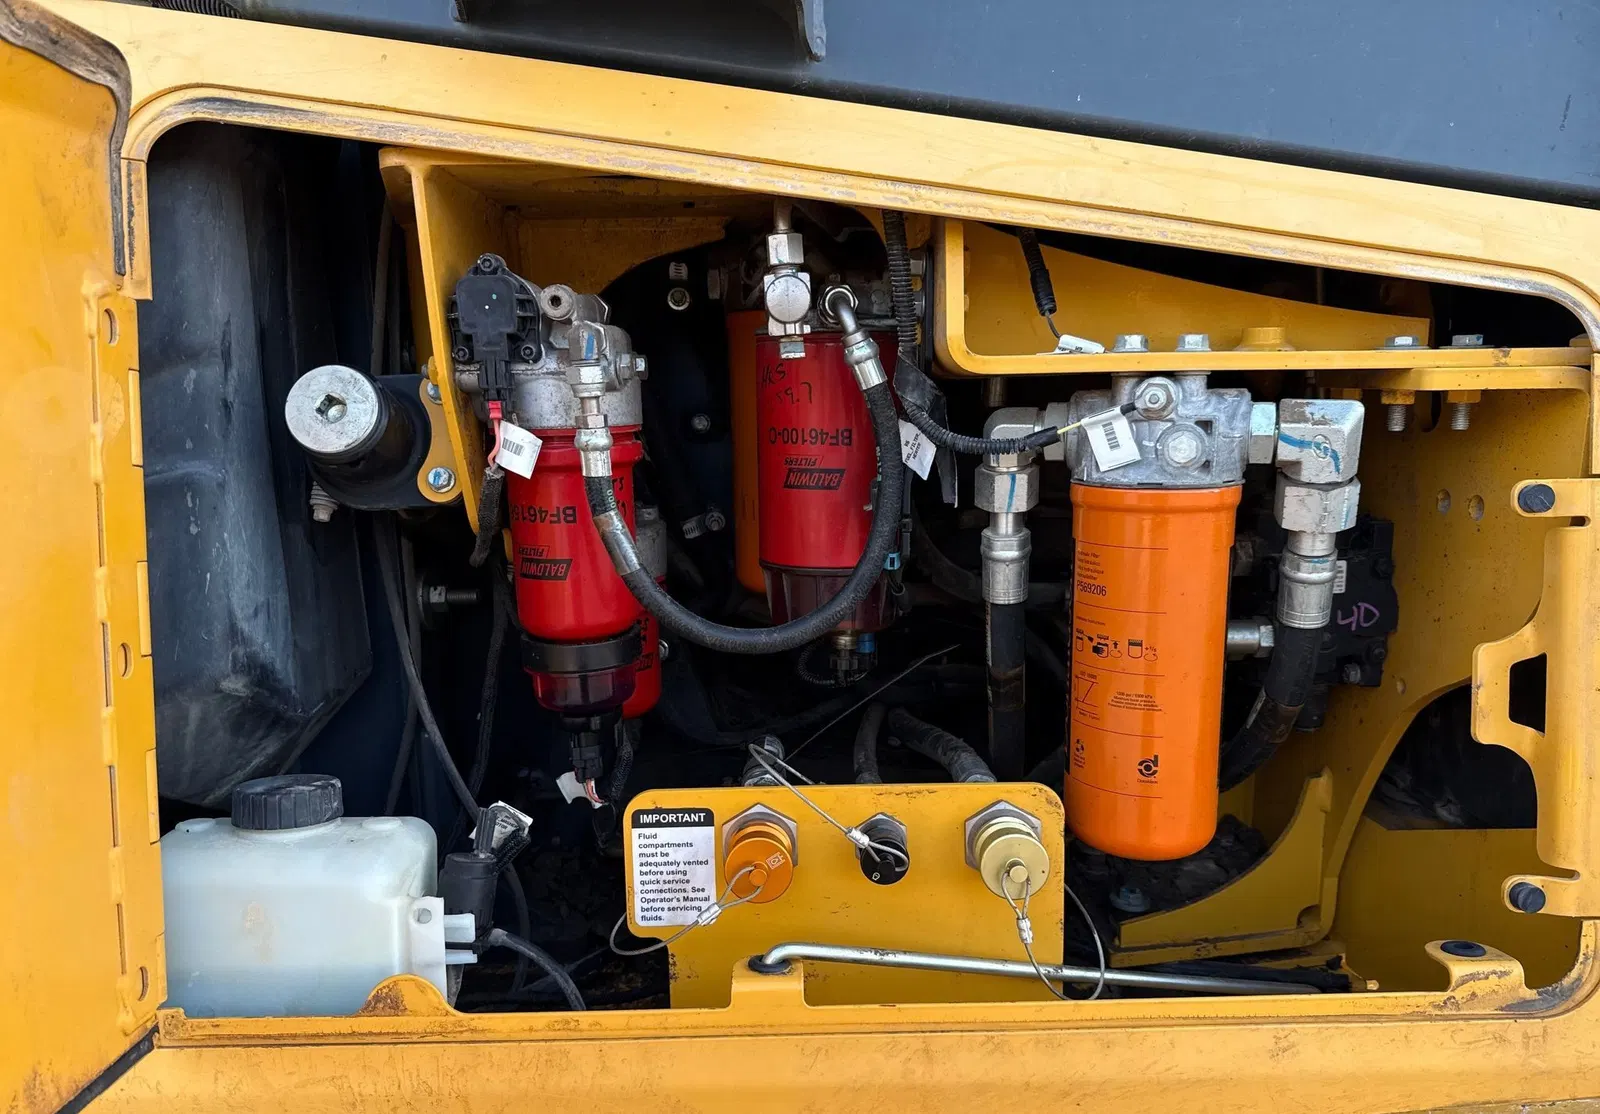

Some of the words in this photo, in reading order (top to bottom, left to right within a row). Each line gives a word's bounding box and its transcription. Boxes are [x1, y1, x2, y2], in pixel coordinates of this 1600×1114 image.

[769, 427, 853, 446] BF46100-C
[784, 456, 817, 466] FILTERS
[787, 472, 840, 486] BALDWIN
[522, 562, 567, 576] BALDWIN
[1077, 580, 1107, 596] P569206
[640, 813, 706, 823] IMPORTANT
